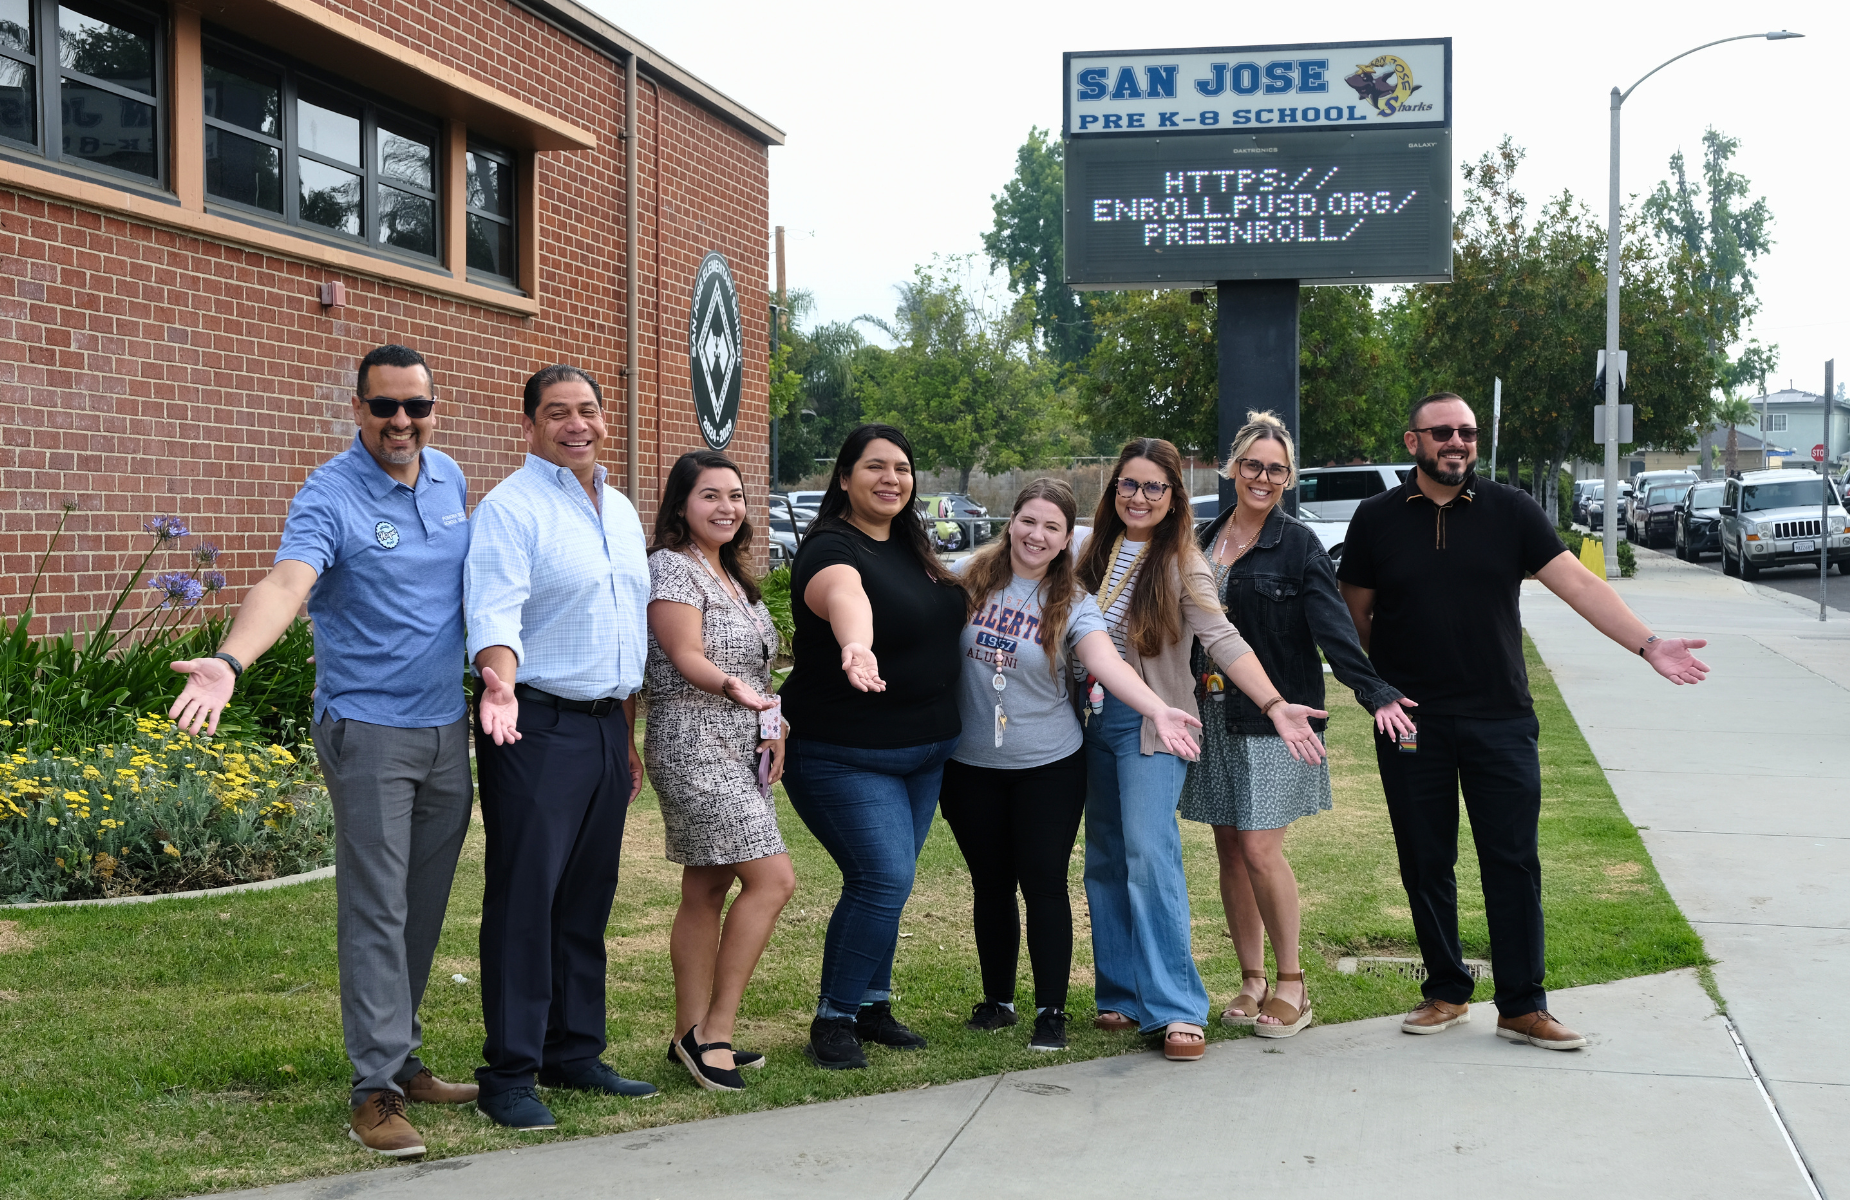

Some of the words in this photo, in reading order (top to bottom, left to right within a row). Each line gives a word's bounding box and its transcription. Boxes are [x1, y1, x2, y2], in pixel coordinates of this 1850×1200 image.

[1077, 64, 1179, 102] SAN
[1194, 58, 1329, 98] JOSE
[1078, 112, 1146, 130] PRE
[1158, 110, 1220, 128] K-8
[1232, 105, 1367, 126] SCHOOL
[1377, 95, 1433, 118] Sharks
[1165, 166, 1338, 194] HTTPS://
[1093, 190, 1417, 222] ENROLL.PUSD.ORG/
[1144, 218, 1364, 246] PREENROLL/
[693, 276, 705, 318] JOSE
[702, 259, 734, 297] ELEMENTARY
[731, 296, 742, 368] SCHOOL
[1812, 449, 1824, 457] STO
[1006, 596, 1042, 614] STAT
[979, 633, 1015, 651] 1957
